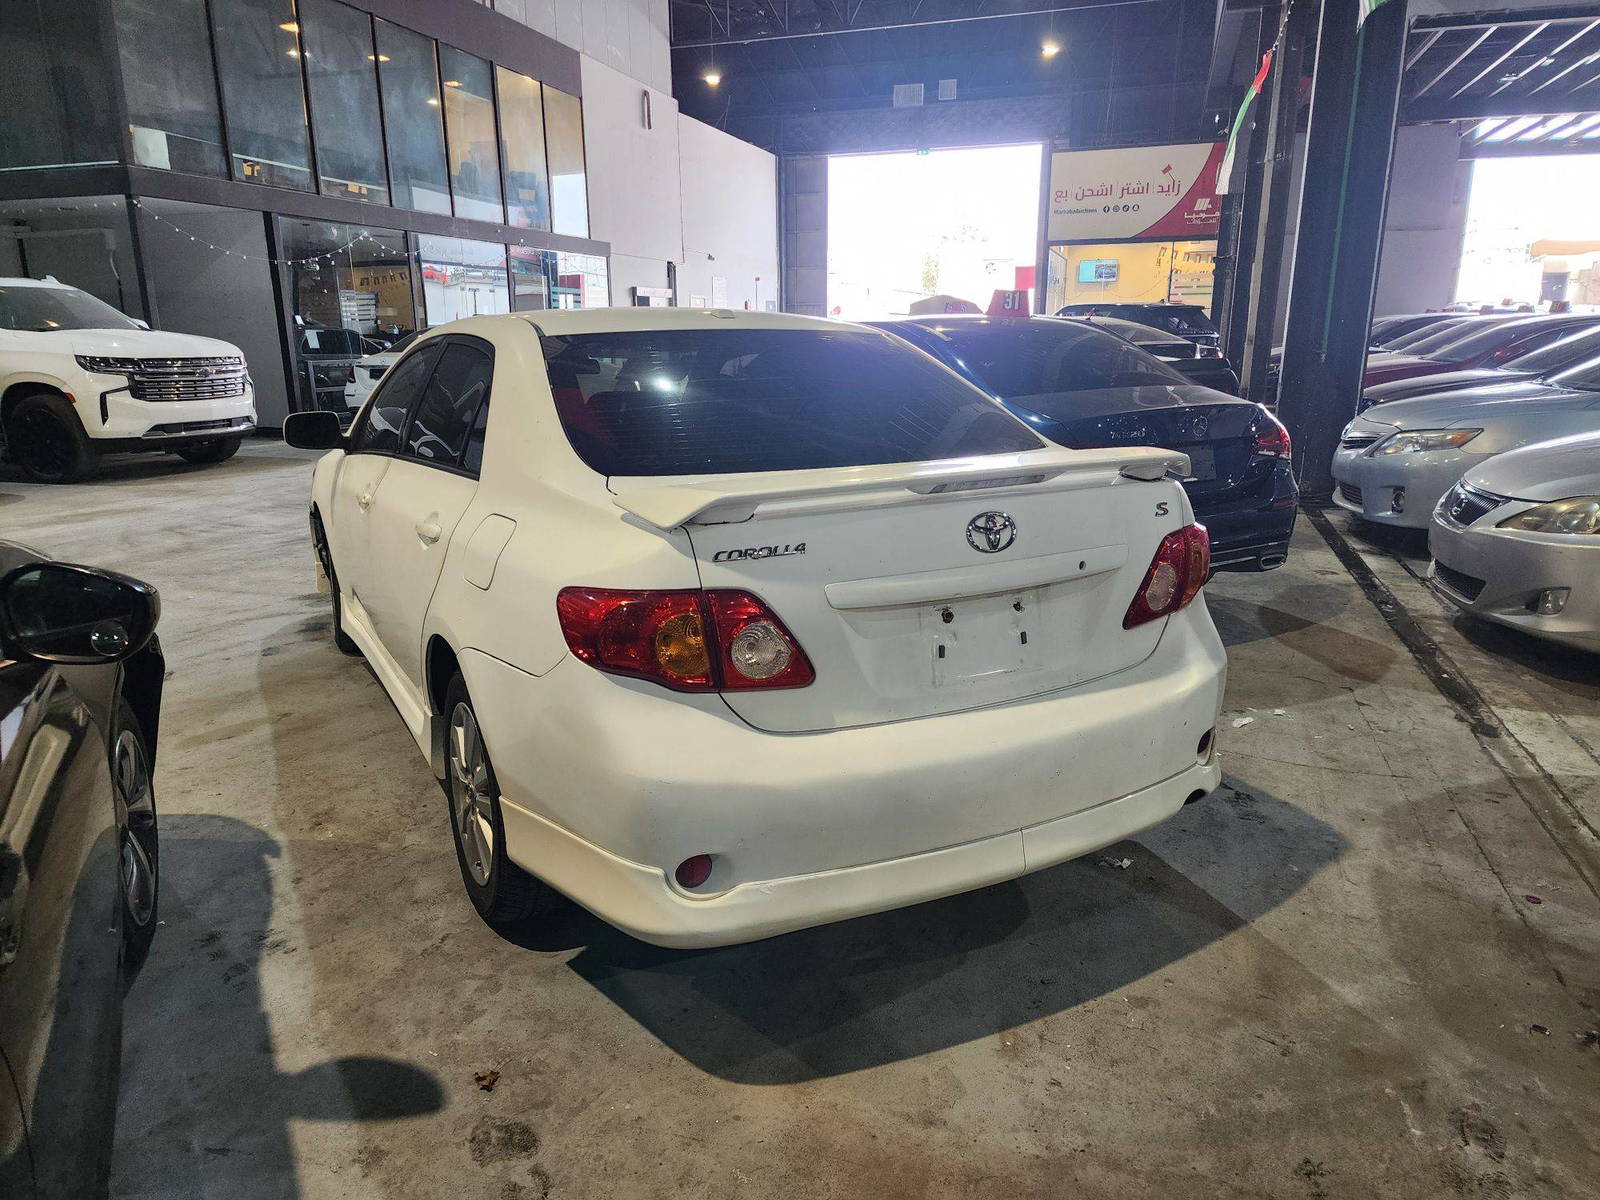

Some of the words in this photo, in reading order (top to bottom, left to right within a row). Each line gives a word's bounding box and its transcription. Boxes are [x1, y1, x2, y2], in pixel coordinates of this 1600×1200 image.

[1003, 290, 1021, 311] 31
[1155, 501, 1169, 517] S
[712, 542, 807, 563] COROLLA
